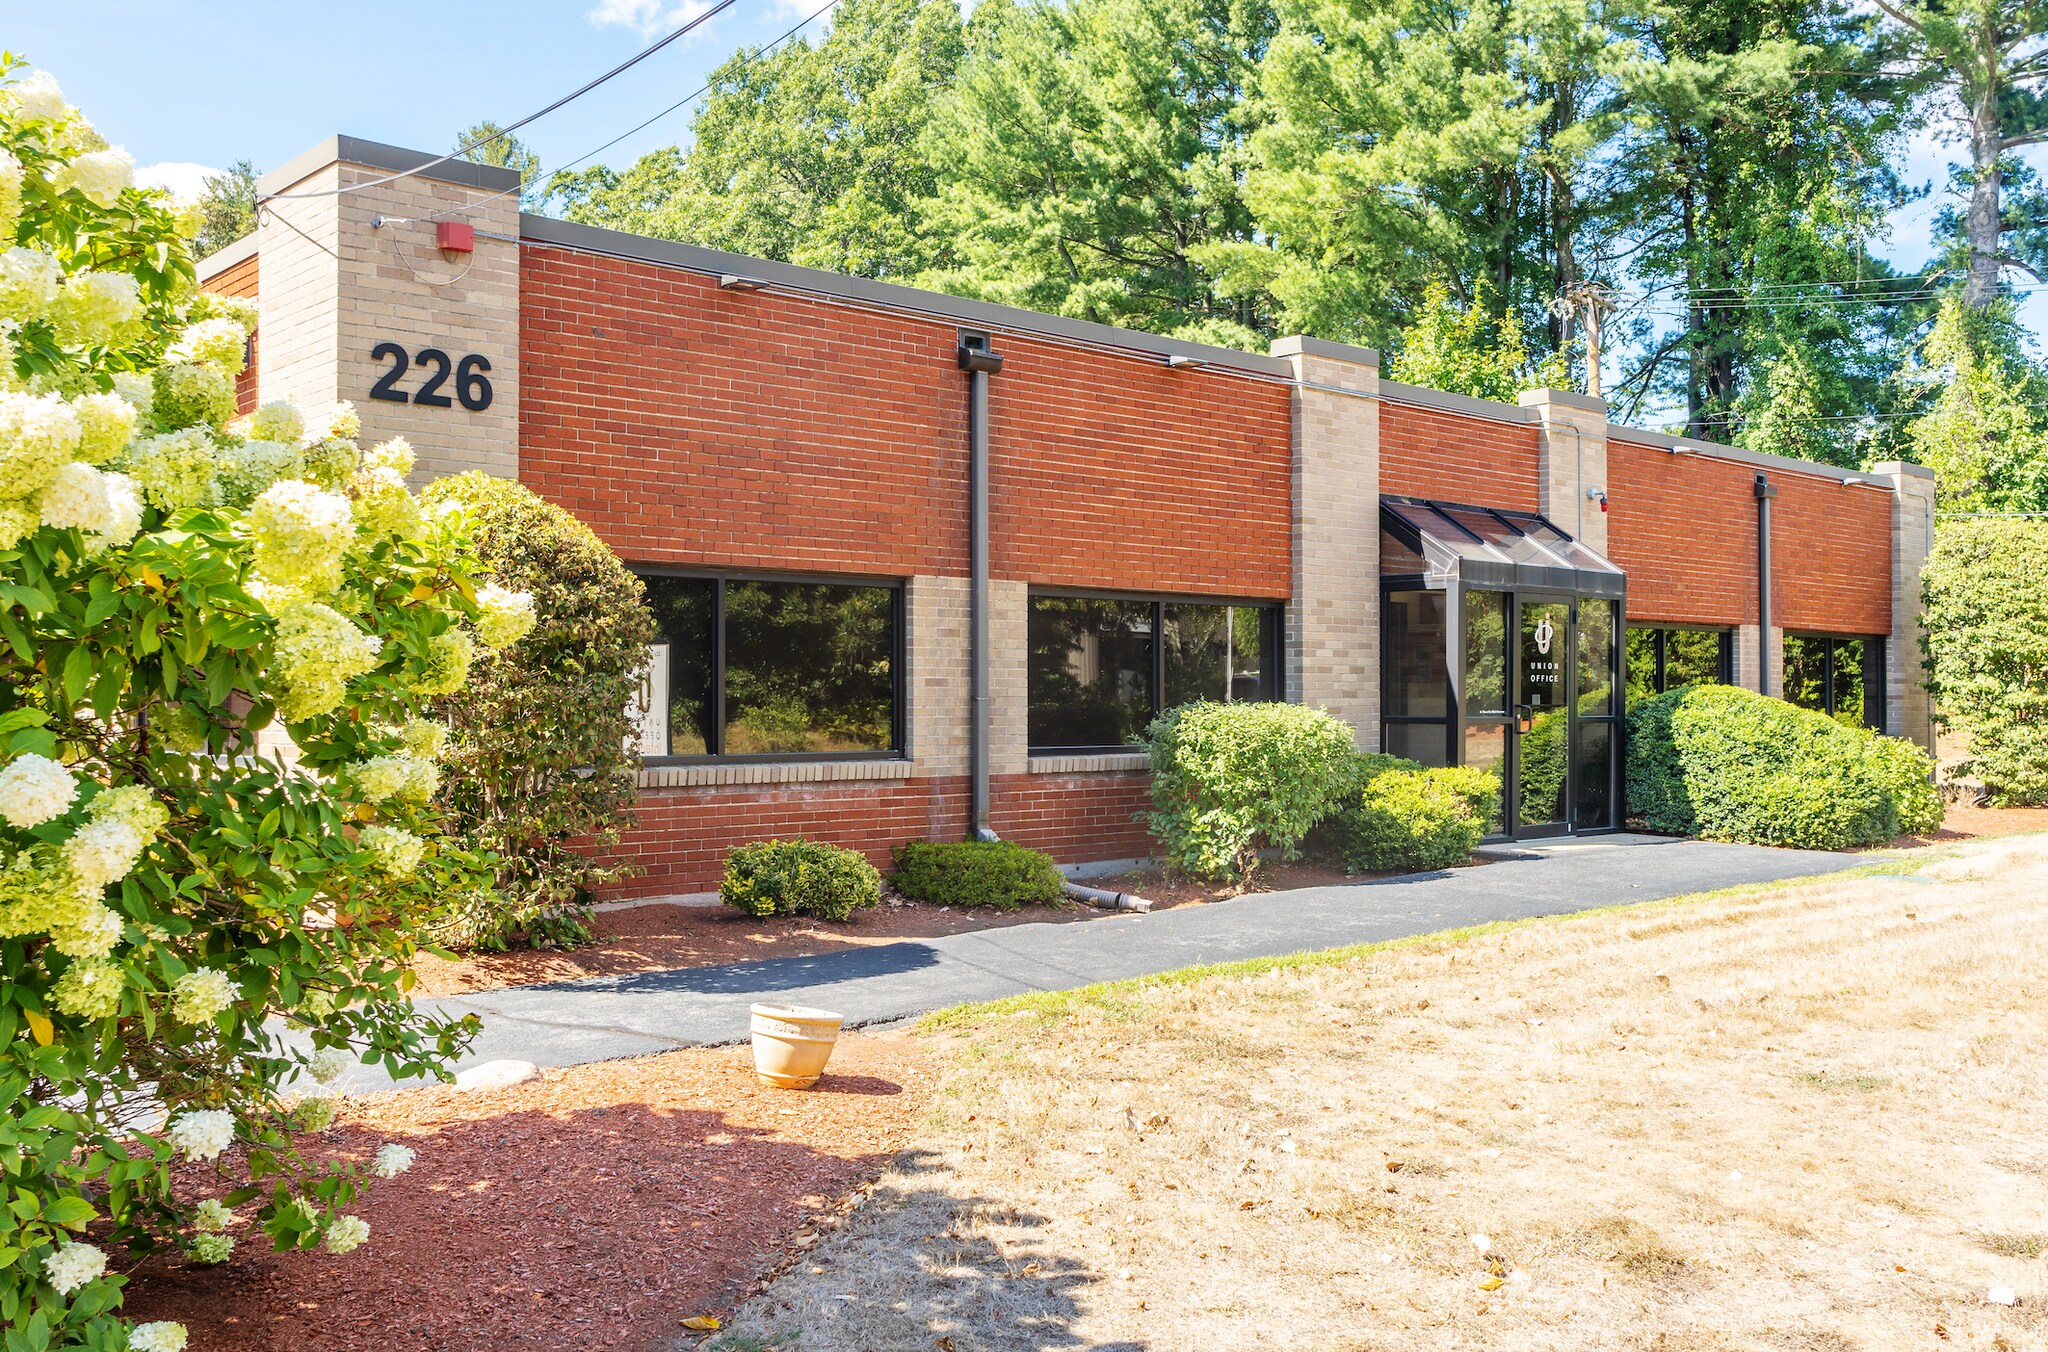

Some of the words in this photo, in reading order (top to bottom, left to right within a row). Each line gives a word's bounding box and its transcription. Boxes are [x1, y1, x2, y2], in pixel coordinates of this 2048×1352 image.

[370, 343, 493, 411] 226
[1530, 662, 1559, 670] UNION
[1530, 674, 1559, 682] OFFICE
